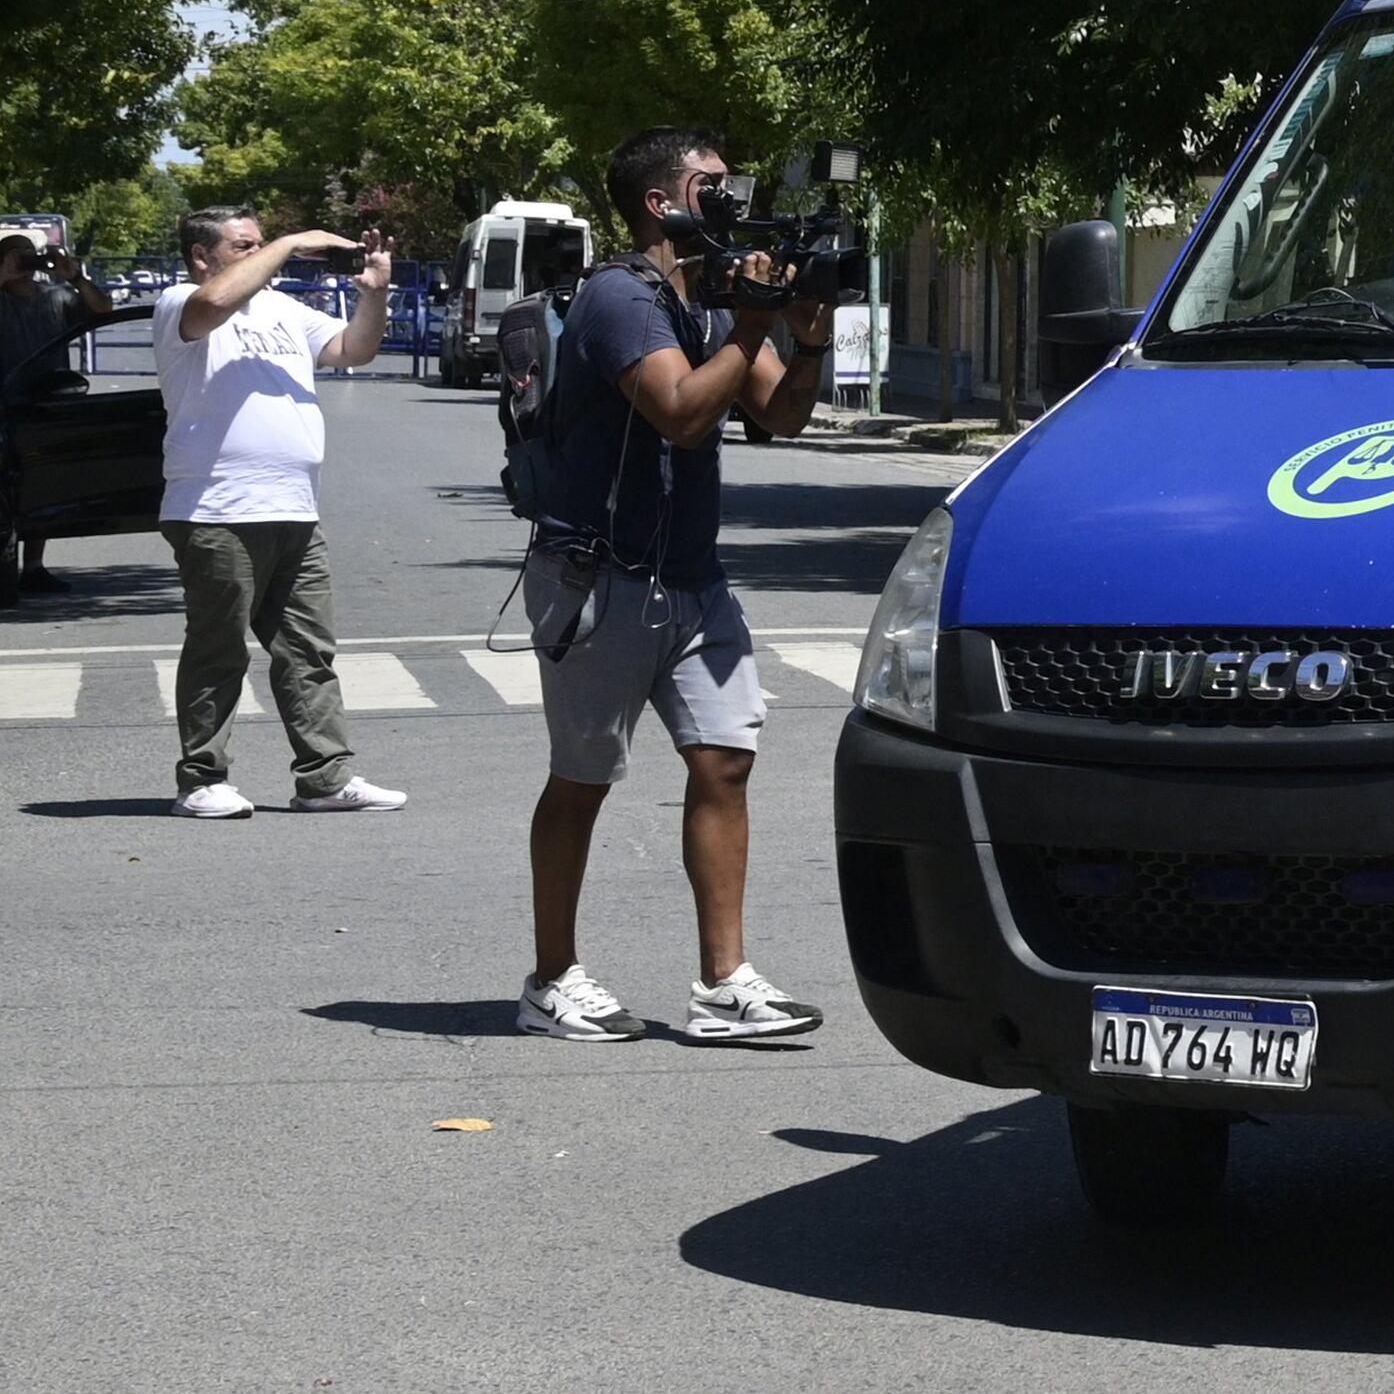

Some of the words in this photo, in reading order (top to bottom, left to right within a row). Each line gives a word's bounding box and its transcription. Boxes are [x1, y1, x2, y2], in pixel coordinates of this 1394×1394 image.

[836, 328, 888, 352] Calzas
[1119, 650, 1354, 701] IVECO
[1202, 1009, 1253, 1022] ARGENTINA
[1101, 1018, 1148, 1066] AD
[1162, 1023, 1233, 1074] 764
